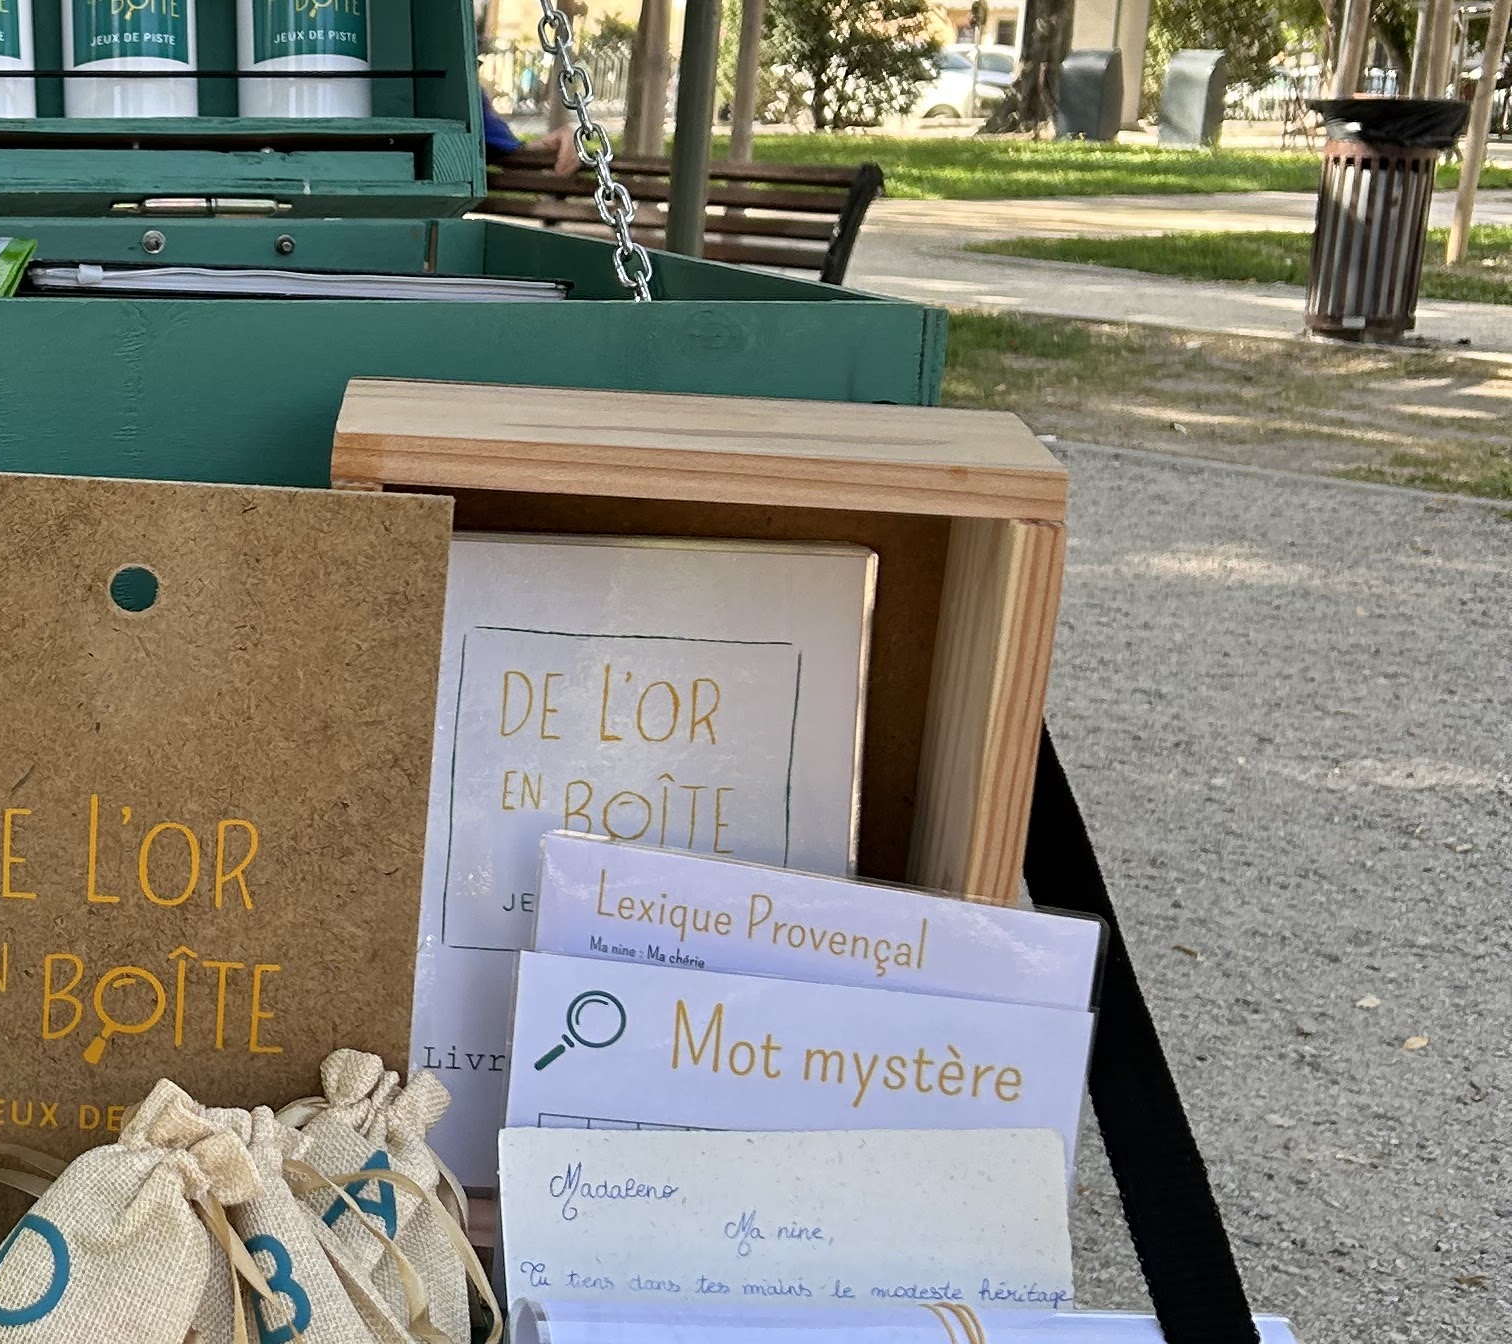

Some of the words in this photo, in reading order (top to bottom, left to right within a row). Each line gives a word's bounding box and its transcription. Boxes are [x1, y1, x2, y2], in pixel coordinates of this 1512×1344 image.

[90, 34, 120, 47] JEUX
[123, 32, 140, 43] DE
[143, 33, 176, 46] PISTE
[273, 30, 305, 44] JEUX
[309, 30, 324, 41] DE
[328, 30, 357, 44] PISTE
[499, 669, 561, 743] DE
[600, 663, 721, 746] L'OR
[501, 770, 543, 811] EN
[563, 773, 736, 855] BOÎTE
[87, 793, 260, 911] L'OR
[502, 893, 535, 912] JE
[596, 869, 733, 937] Lexique
[747, 893, 928, 978] Provençal
[589, 934, 609, 954] Ma
[611, 941, 636, 958] nine
[647, 944, 666, 964] Ma
[669, 947, 706, 969] chérie
[42, 946, 284, 1065] BOÎTE
[423, 1045, 505, 1071] Livr
[670, 999, 782, 1077] Mot
[802, 1045, 1025, 1108] mystère
[79, 1103, 122, 1131] DE
[321, 1149, 399, 1242] A
[724, 1210, 765, 1257] Ma
[566, 1270, 615, 1291] tiens
[629, 1274, 681, 1293] dans
[697, 1274, 731, 1295] tes
[742, 1280, 812, 1298] mains
[833, 1279, 856, 1299] le
[870, 1280, 964, 1301] modeste
[979, 1278, 1073, 1308] héritage
